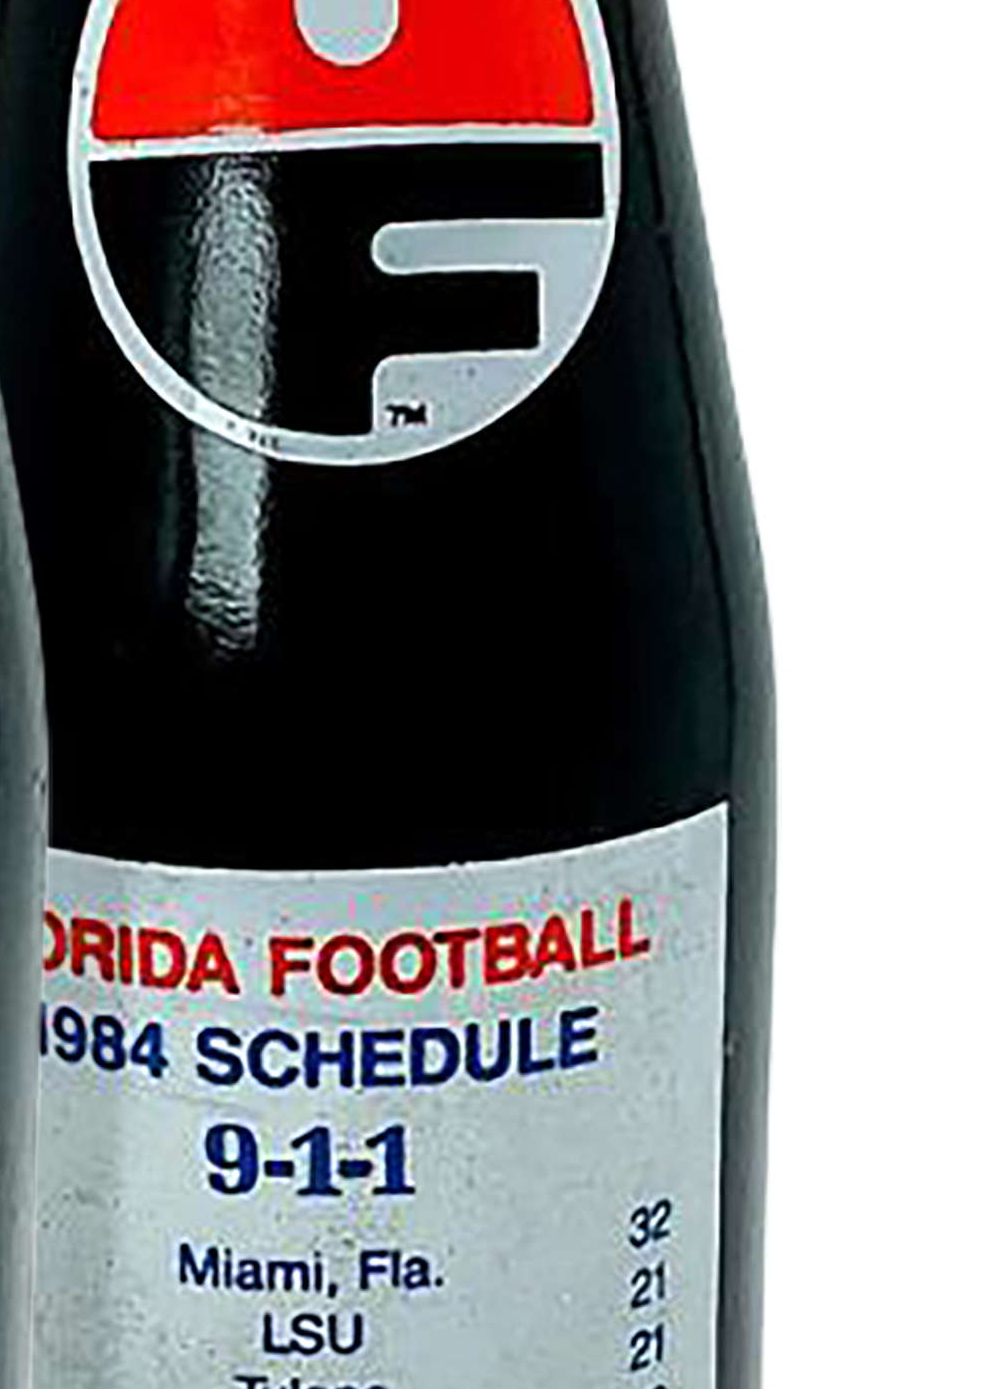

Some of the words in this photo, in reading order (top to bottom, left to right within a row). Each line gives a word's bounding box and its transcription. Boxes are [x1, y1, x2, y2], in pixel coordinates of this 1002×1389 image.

[268, 898, 651, 997] FOOTBALL
[40, 1001, 170, 1079] 1984
[196, 1007, 600, 1089] SCHEDULE
[205, 1121, 416, 1198] 9-1-1
[629, 1199, 672, 1249] 32
[178, 1242, 339, 1299] Miami,
[359, 1248, 445, 1290] Fla.
[630, 1263, 668, 1310] 21
[262, 1313, 364, 1355] LSU
[629, 1324, 666, 1372] 21
